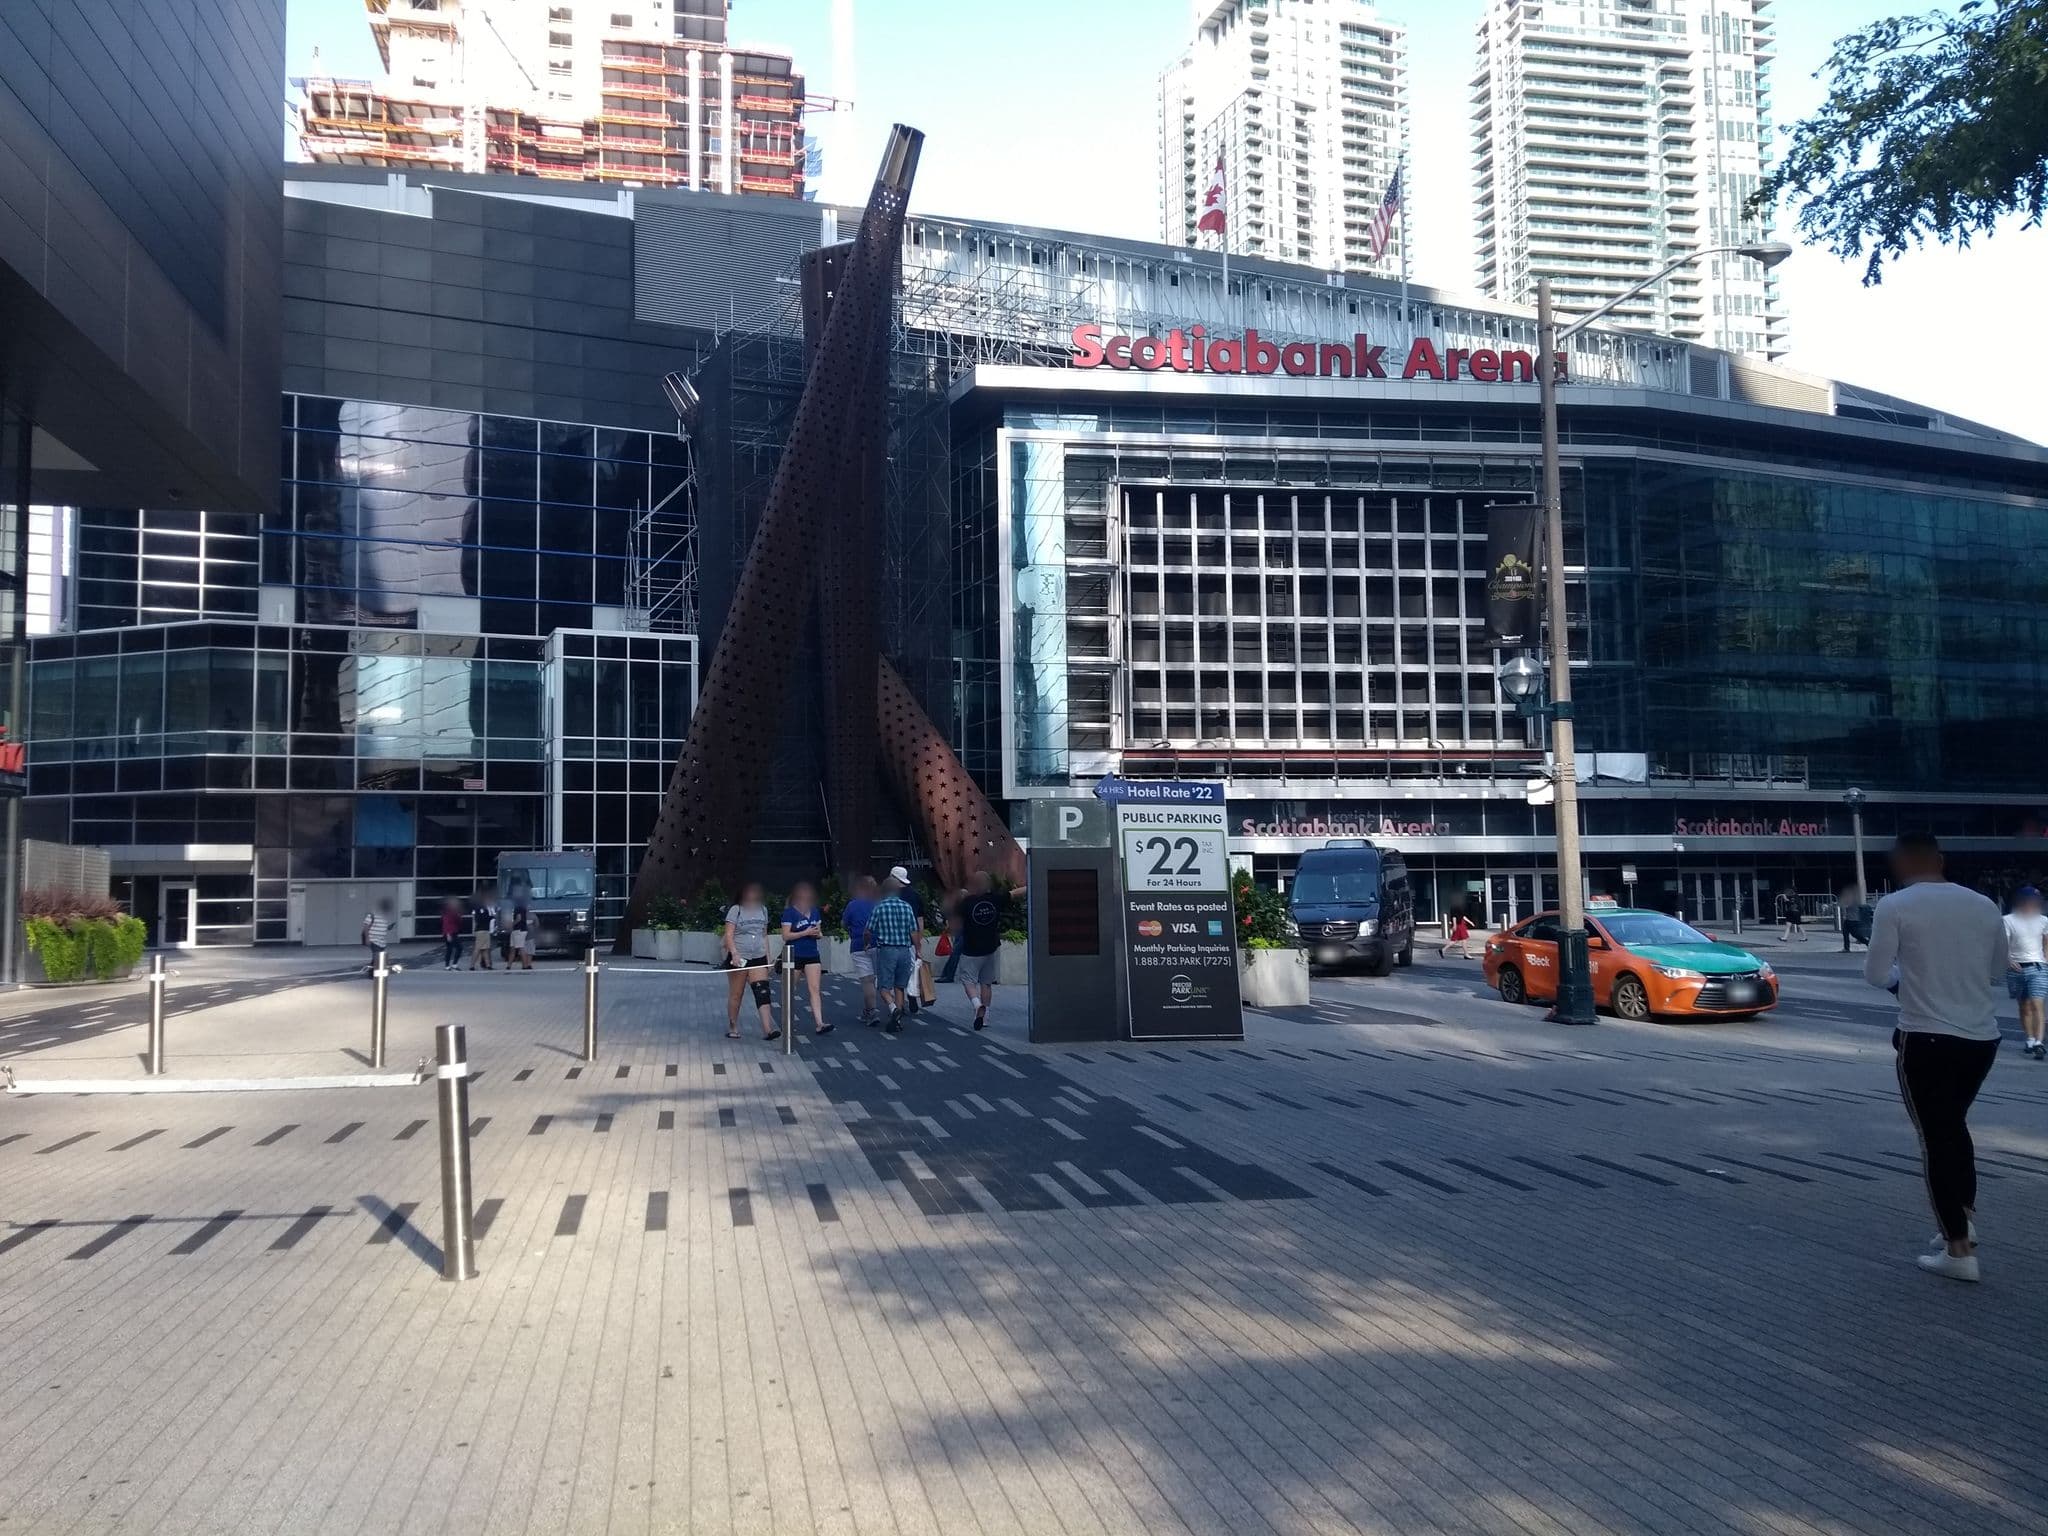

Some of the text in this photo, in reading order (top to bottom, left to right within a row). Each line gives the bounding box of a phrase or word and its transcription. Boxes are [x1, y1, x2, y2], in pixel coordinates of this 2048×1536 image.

[1071, 324, 1389, 379] Scotiabank
[1098, 786, 1107, 794] 24
[1127, 785, 1160, 798] Hotel
[1163, 786, 1191, 799] Rate
[1192, 786, 1213, 800] $22
[1058, 806, 1084, 841] P
[1122, 812, 1223, 825] PUBLIC PARKING
[1242, 818, 1450, 837] Scotiabank Arena
[1677, 818, 1773, 836] Scotiabank
[1146, 878, 1202, 887] For 24 Hours
[1130, 901, 1228, 914] Event Rates as posted
[1171, 923, 1197, 933] VISA
[1133, 944, 1230, 953] Monthly Parking Inquiries
[1524, 953, 1551, 968] Beck
